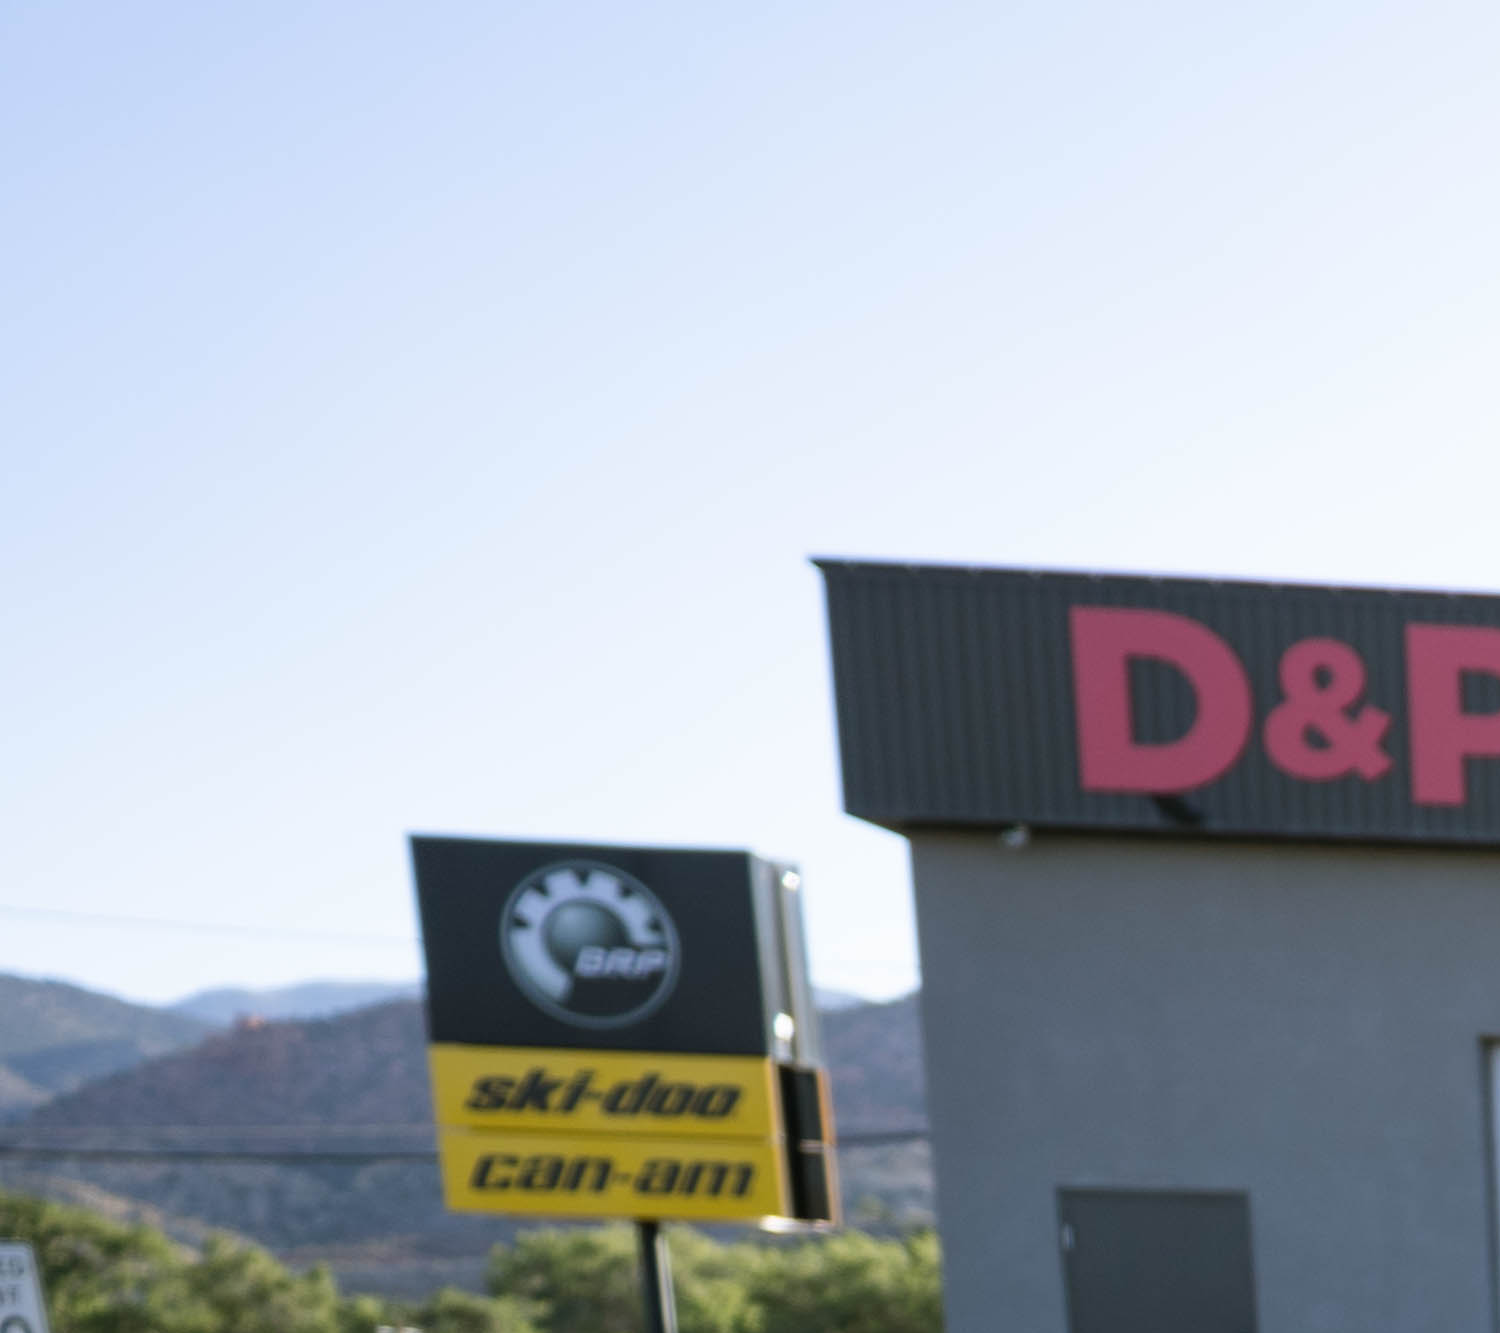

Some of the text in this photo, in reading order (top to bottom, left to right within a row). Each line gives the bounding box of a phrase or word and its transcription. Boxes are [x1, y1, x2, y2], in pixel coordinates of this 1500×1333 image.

[574, 945, 667, 979] BRP
[467, 1066, 742, 1120] ski-doo
[470, 1152, 755, 1200] can-am
